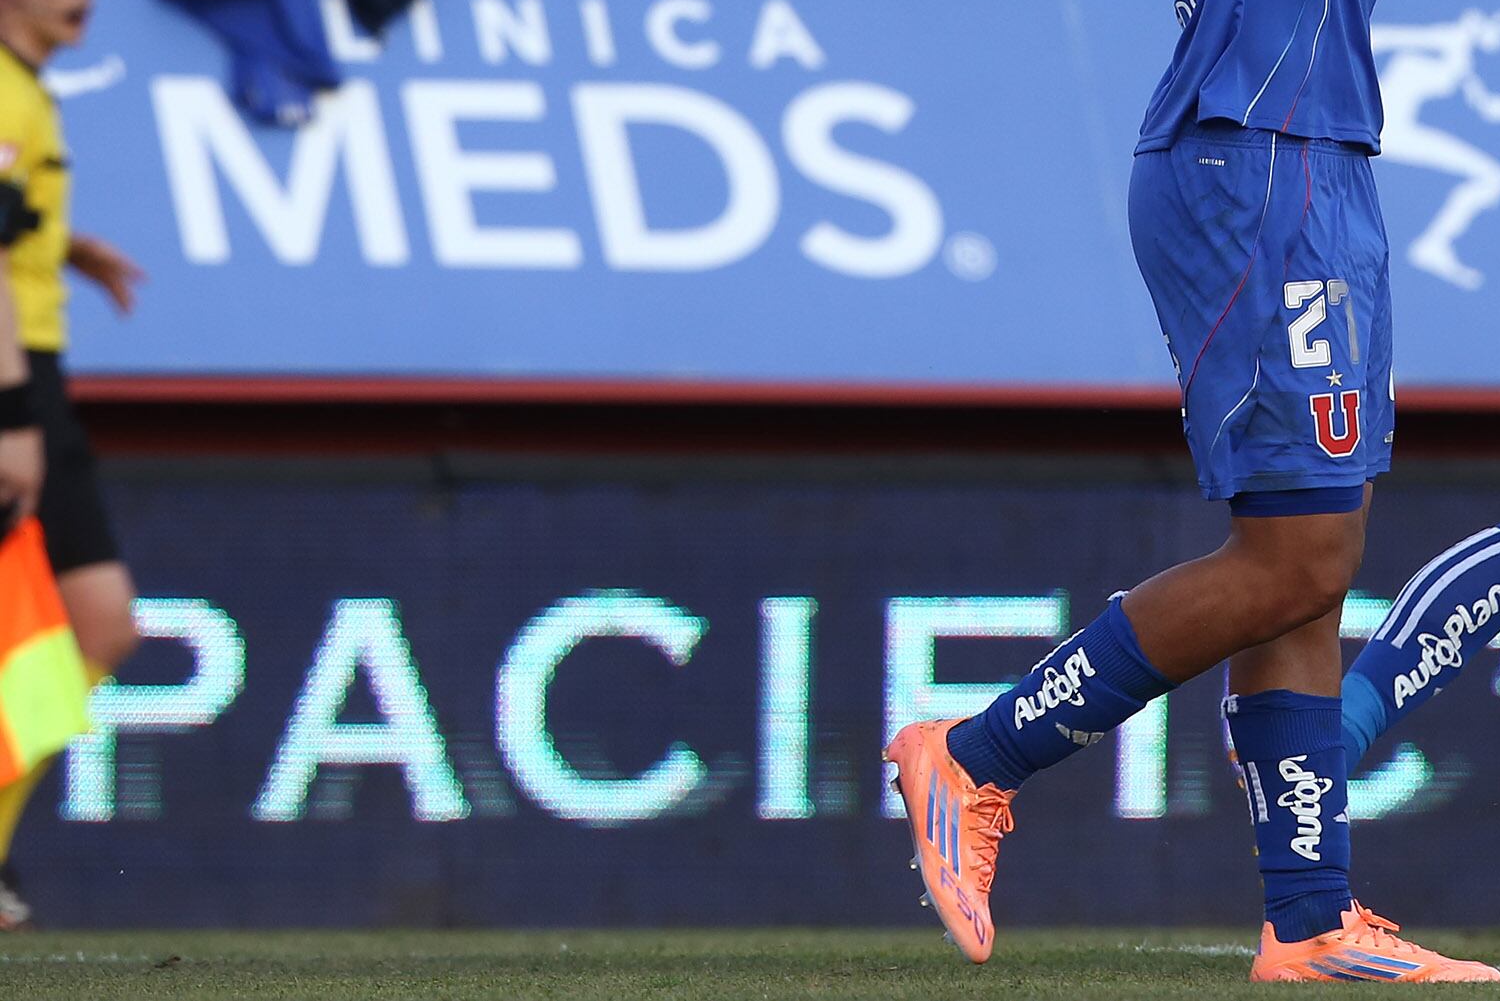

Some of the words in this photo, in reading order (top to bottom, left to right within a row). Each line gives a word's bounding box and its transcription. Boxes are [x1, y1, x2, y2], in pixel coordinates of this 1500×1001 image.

[150, 75, 945, 280] MEDS
[1283, 279, 1360, 368] 27
[1309, 389, 1361, 459] U
